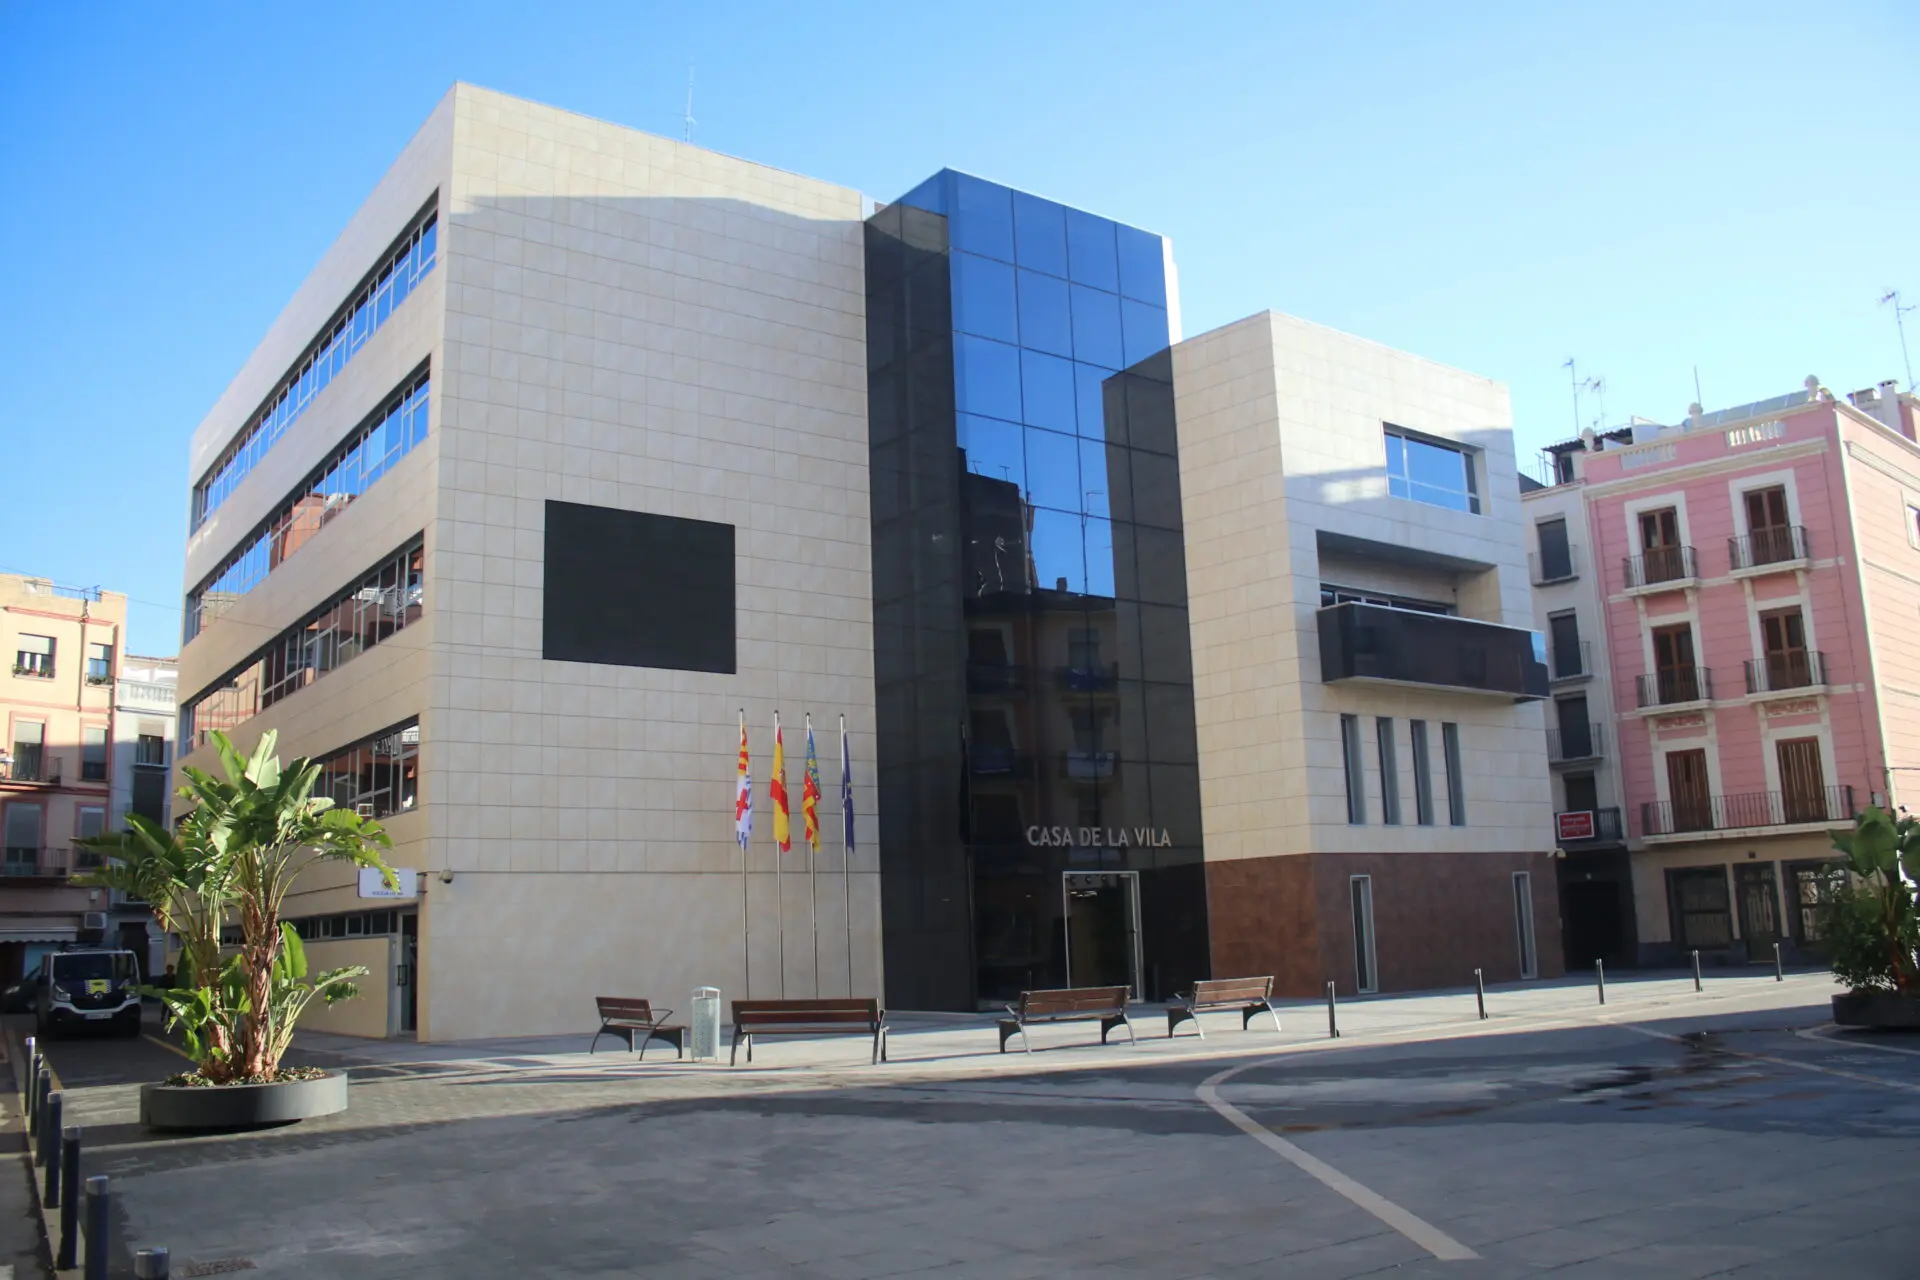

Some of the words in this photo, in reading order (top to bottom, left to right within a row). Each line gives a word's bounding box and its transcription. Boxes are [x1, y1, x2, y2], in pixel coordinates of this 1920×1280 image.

[1026, 826, 1073, 847] CASA
[1079, 826, 1102, 847] DE
[1108, 827, 1129, 847] LA
[1134, 827, 1172, 848] VILA
